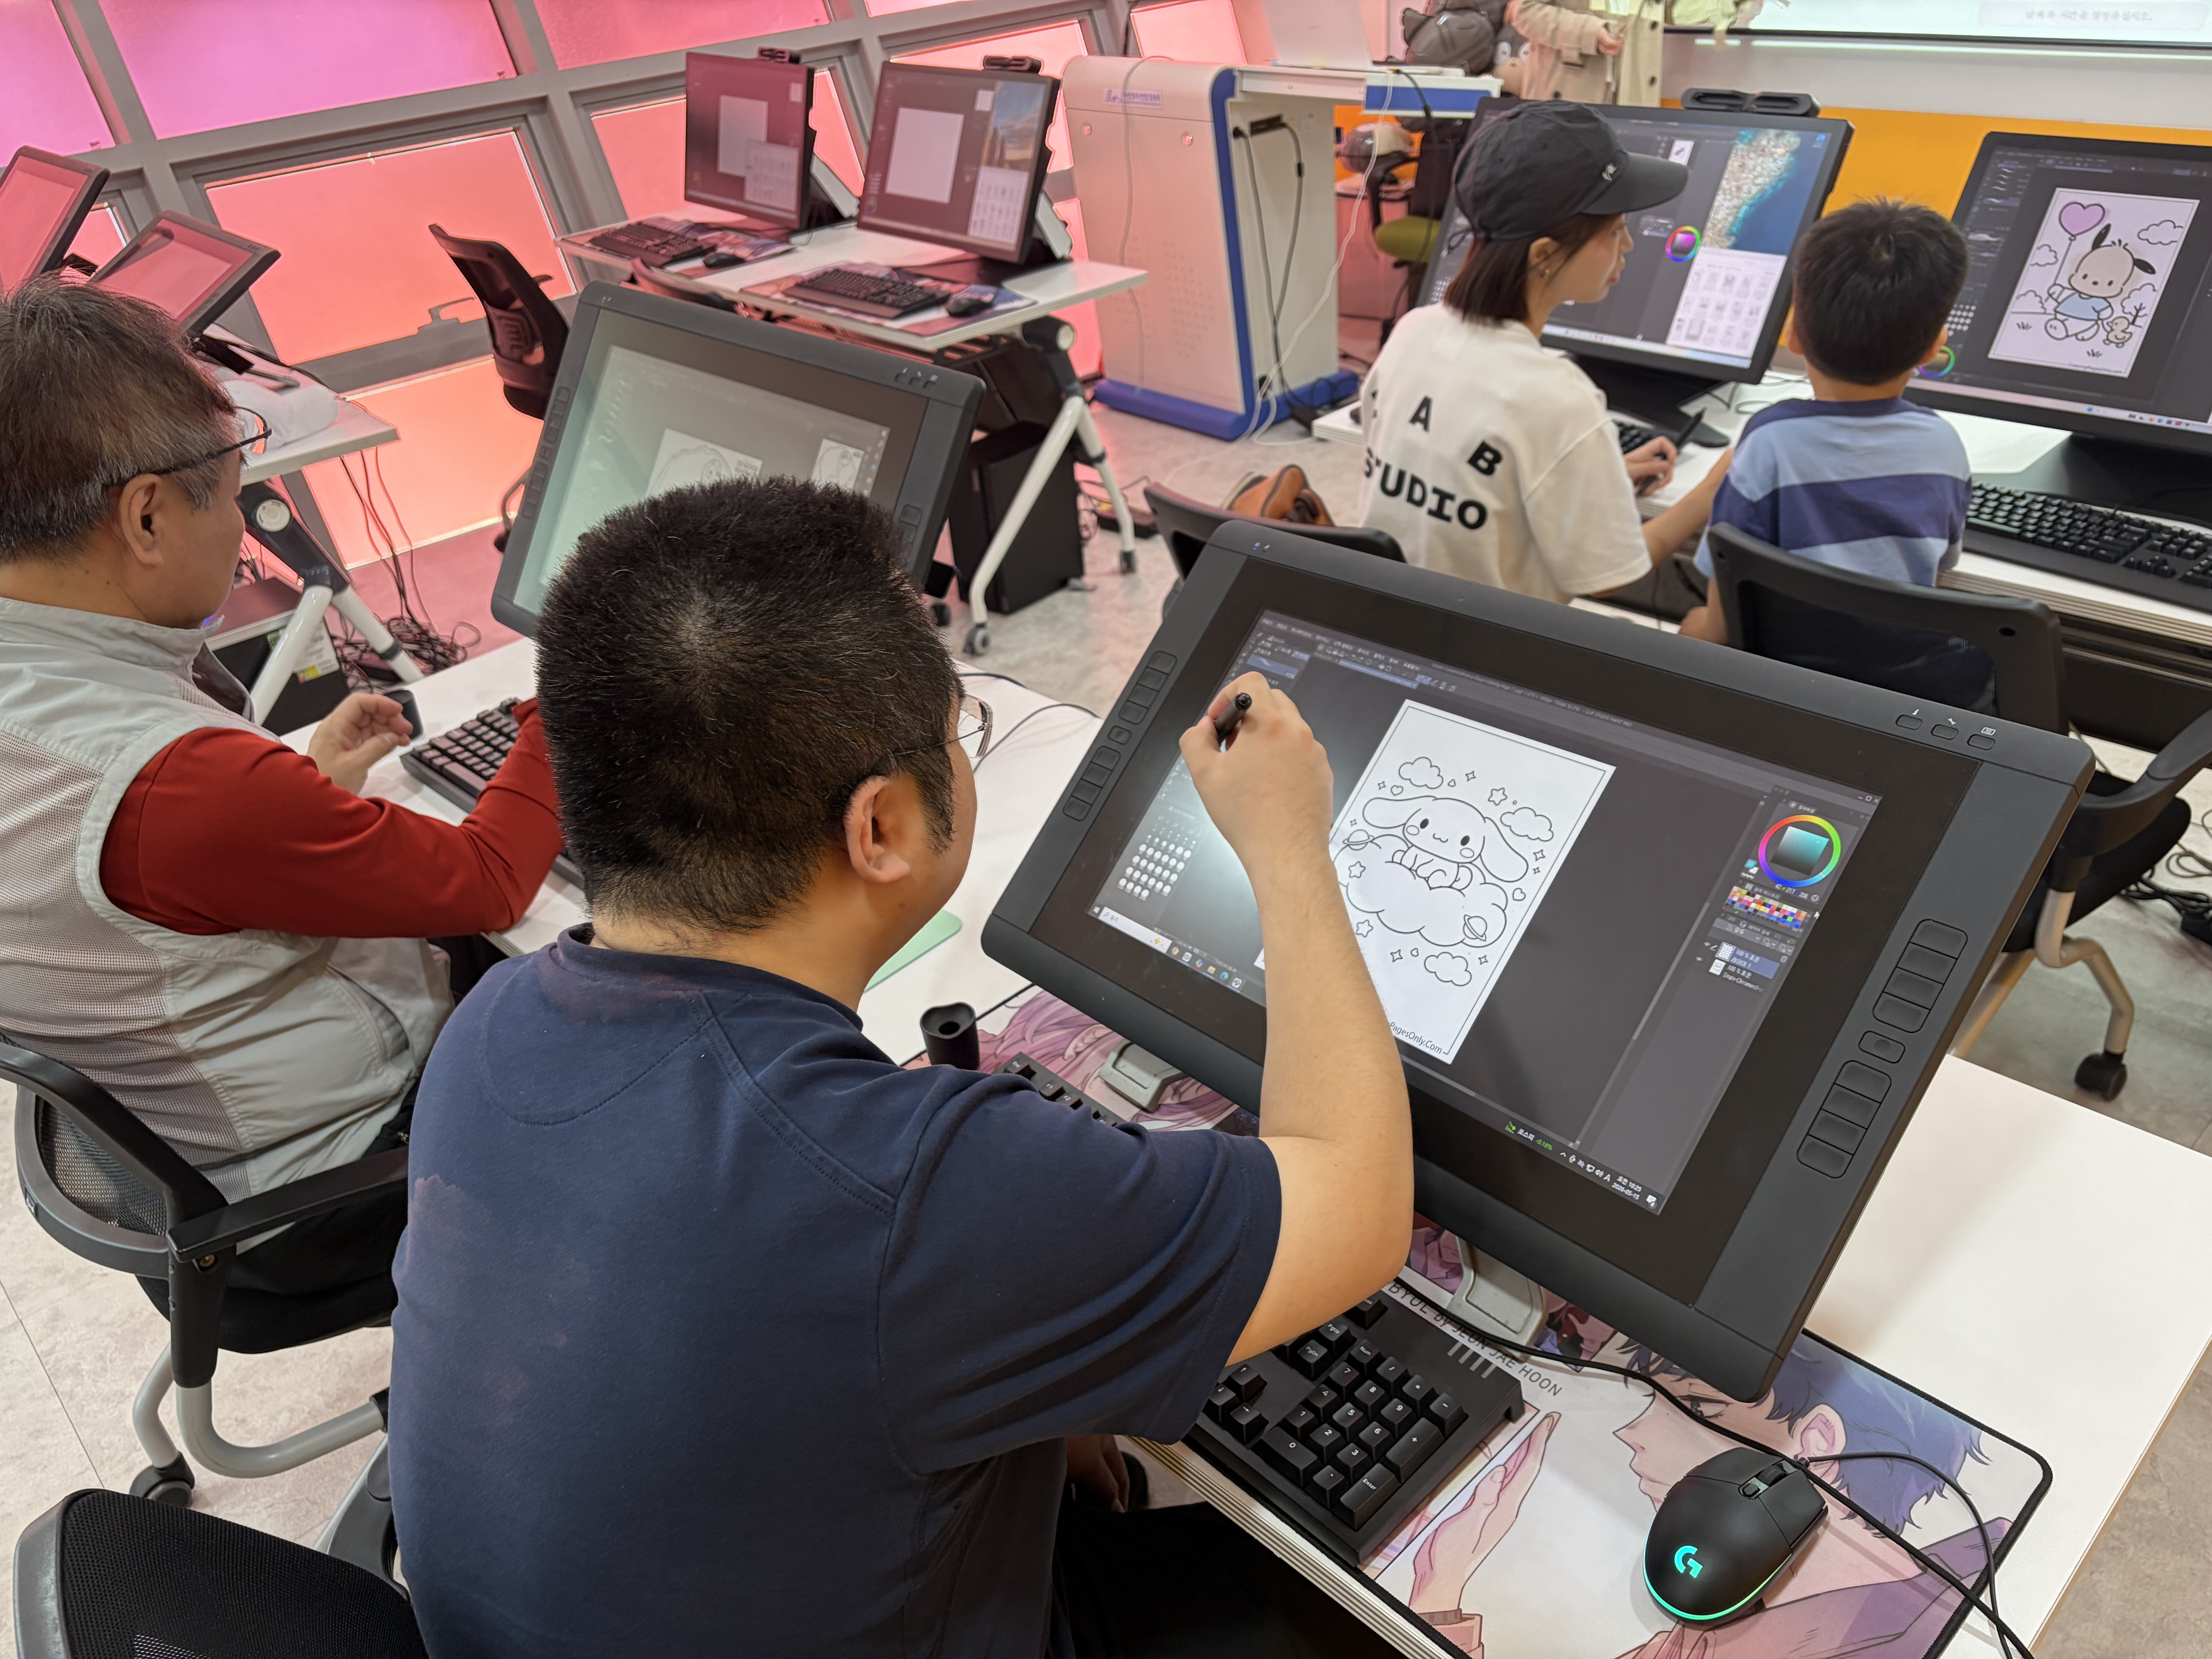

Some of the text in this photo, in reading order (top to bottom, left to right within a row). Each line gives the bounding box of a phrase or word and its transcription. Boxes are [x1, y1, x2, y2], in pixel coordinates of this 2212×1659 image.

[1365, 447, 1488, 530] SUDIO
[1389, 1021, 1443, 1054] PagesOnly.Com
[1517, 1128, 1535, 1141] 코스피
[1328, 1323, 1340, 1334] PgUp
[1359, 1346, 1371, 1356] Num
[1518, 1365, 1563, 1396] HOON
[1362, 1478, 1377, 1490] Enter
